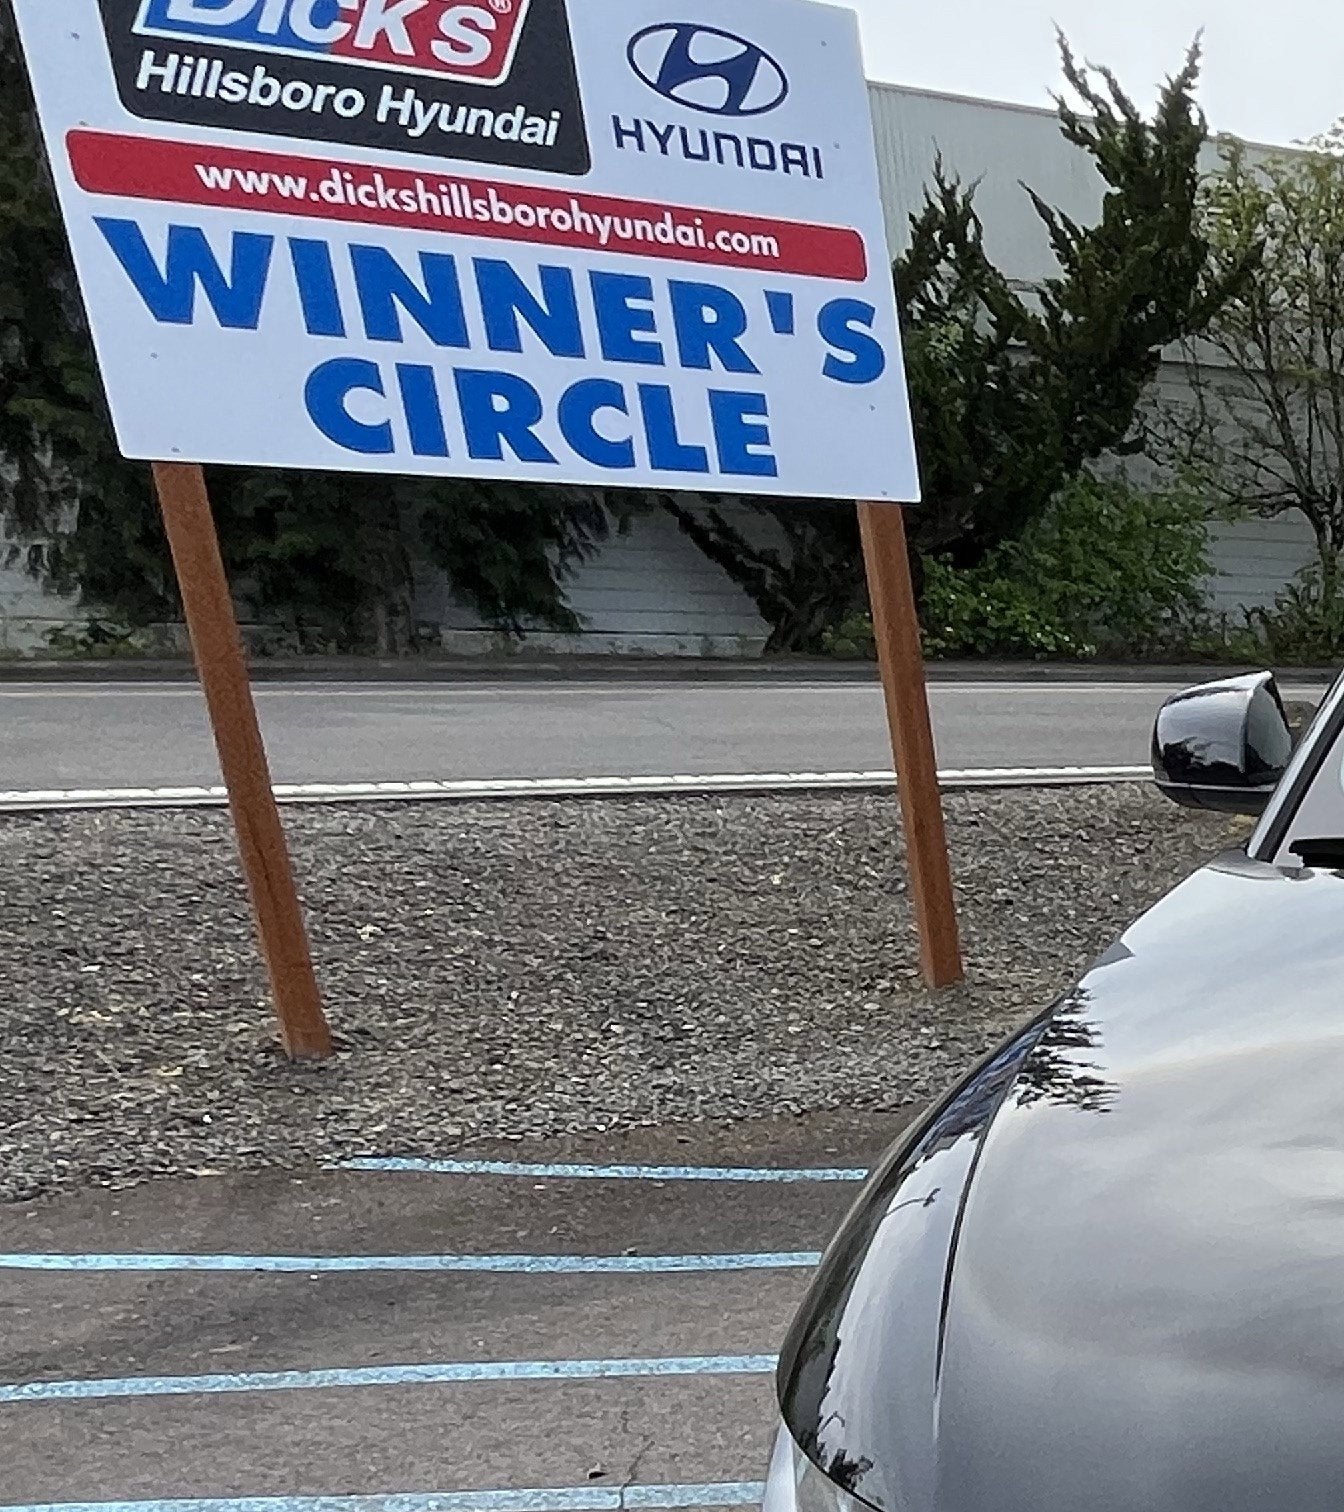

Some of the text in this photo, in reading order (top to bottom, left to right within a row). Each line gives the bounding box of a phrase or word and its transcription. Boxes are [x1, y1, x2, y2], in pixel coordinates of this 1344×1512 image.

[136, 50, 559, 148] Hillsboro Hyundai
[611, 114, 825, 180] HYUNDAI
[194, 162, 781, 260] www.dickshillsborohyundai.com
[93, 215, 888, 385] WINNER'S
[303, 358, 780, 478] CIRCLE
